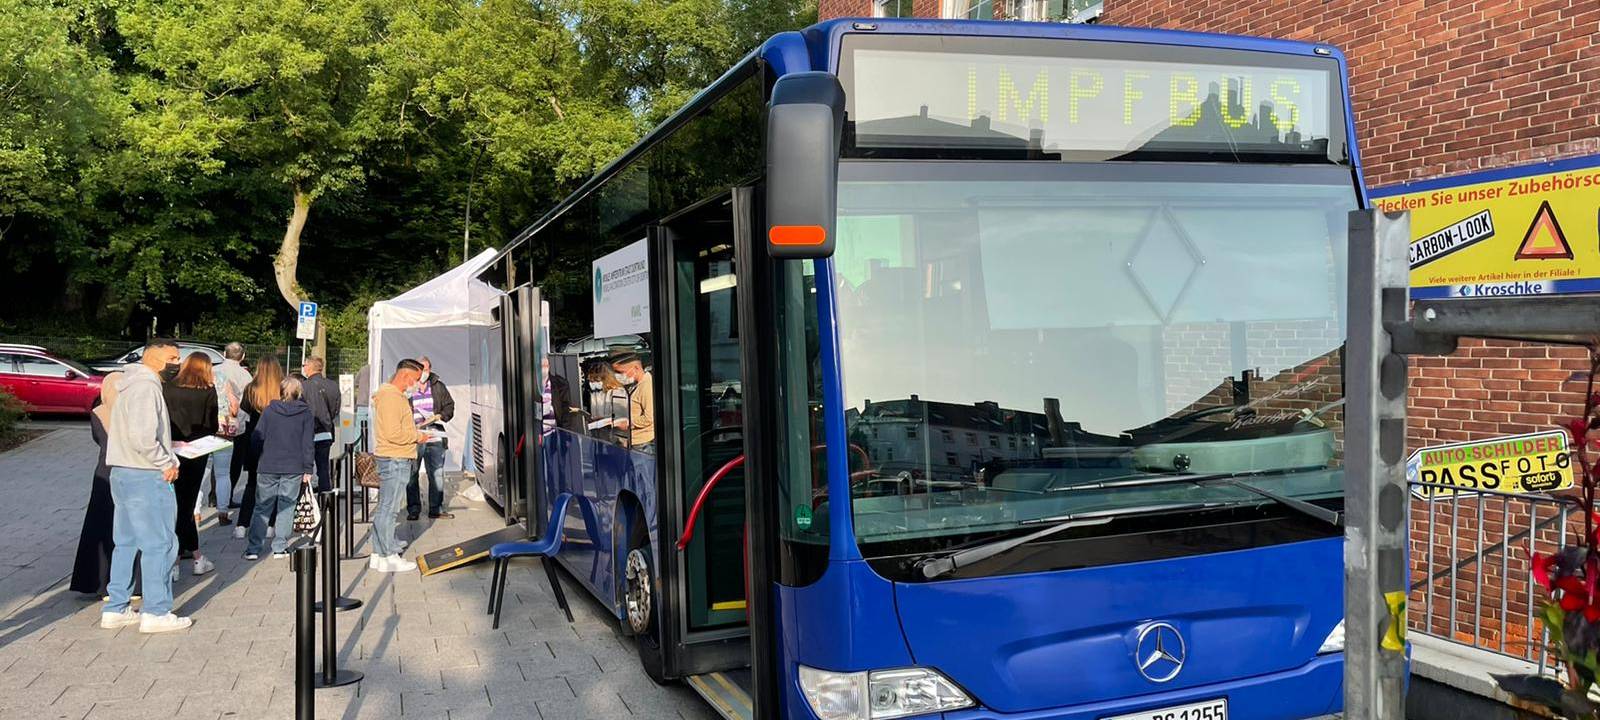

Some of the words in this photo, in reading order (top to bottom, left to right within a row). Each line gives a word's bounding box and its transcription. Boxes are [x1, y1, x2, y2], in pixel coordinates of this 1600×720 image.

[968, 63, 1301, 131] IMPFBUS
[1431, 192, 1453, 206] Sie
[1458, 185, 1503, 203] unser
[1409, 213, 1491, 263] CARBON-LOOK
[1429, 276, 1446, 284] Viele
[1448, 274, 1476, 283] weitere
[1478, 272, 1504, 282] Artikel
[1506, 271, 1521, 280] hier
[1534, 270, 1547, 278] der
[1550, 268, 1575, 277] Filiale
[1475, 281, 1543, 296] Kroschke
[303, 304, 313, 317] P
